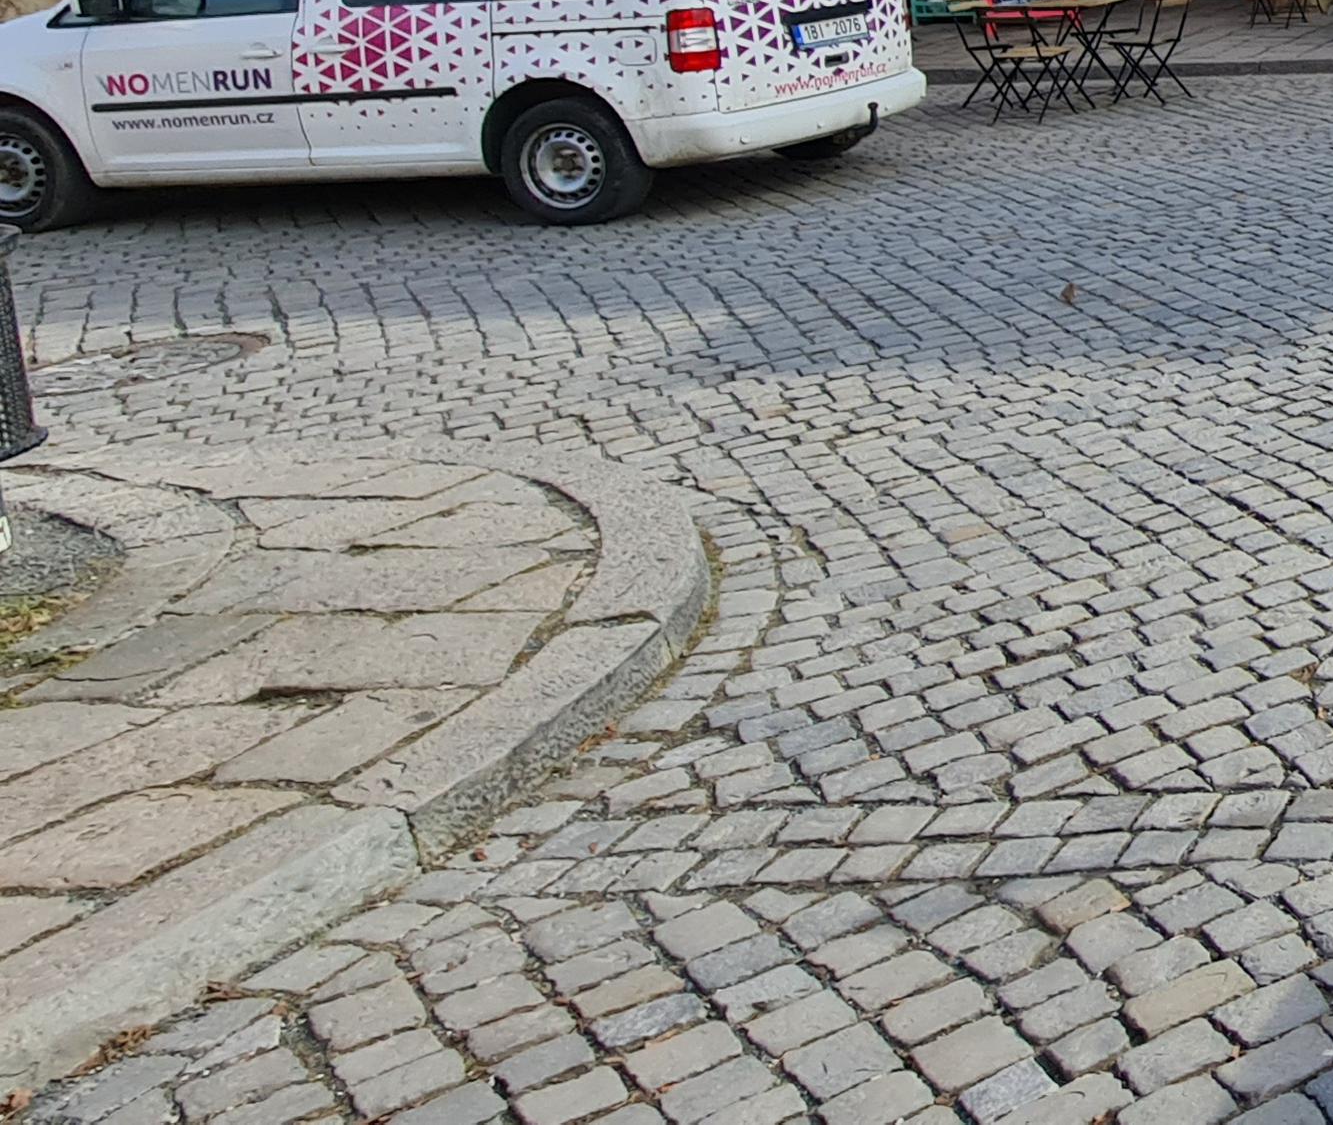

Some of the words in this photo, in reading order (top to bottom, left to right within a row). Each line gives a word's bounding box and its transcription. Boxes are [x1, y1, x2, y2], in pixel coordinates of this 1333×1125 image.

[834, 17, 862, 35] 2076
[97, 68, 273, 97] NOMENRUN
[112, 112, 275, 131] www.nomenrun.cz
